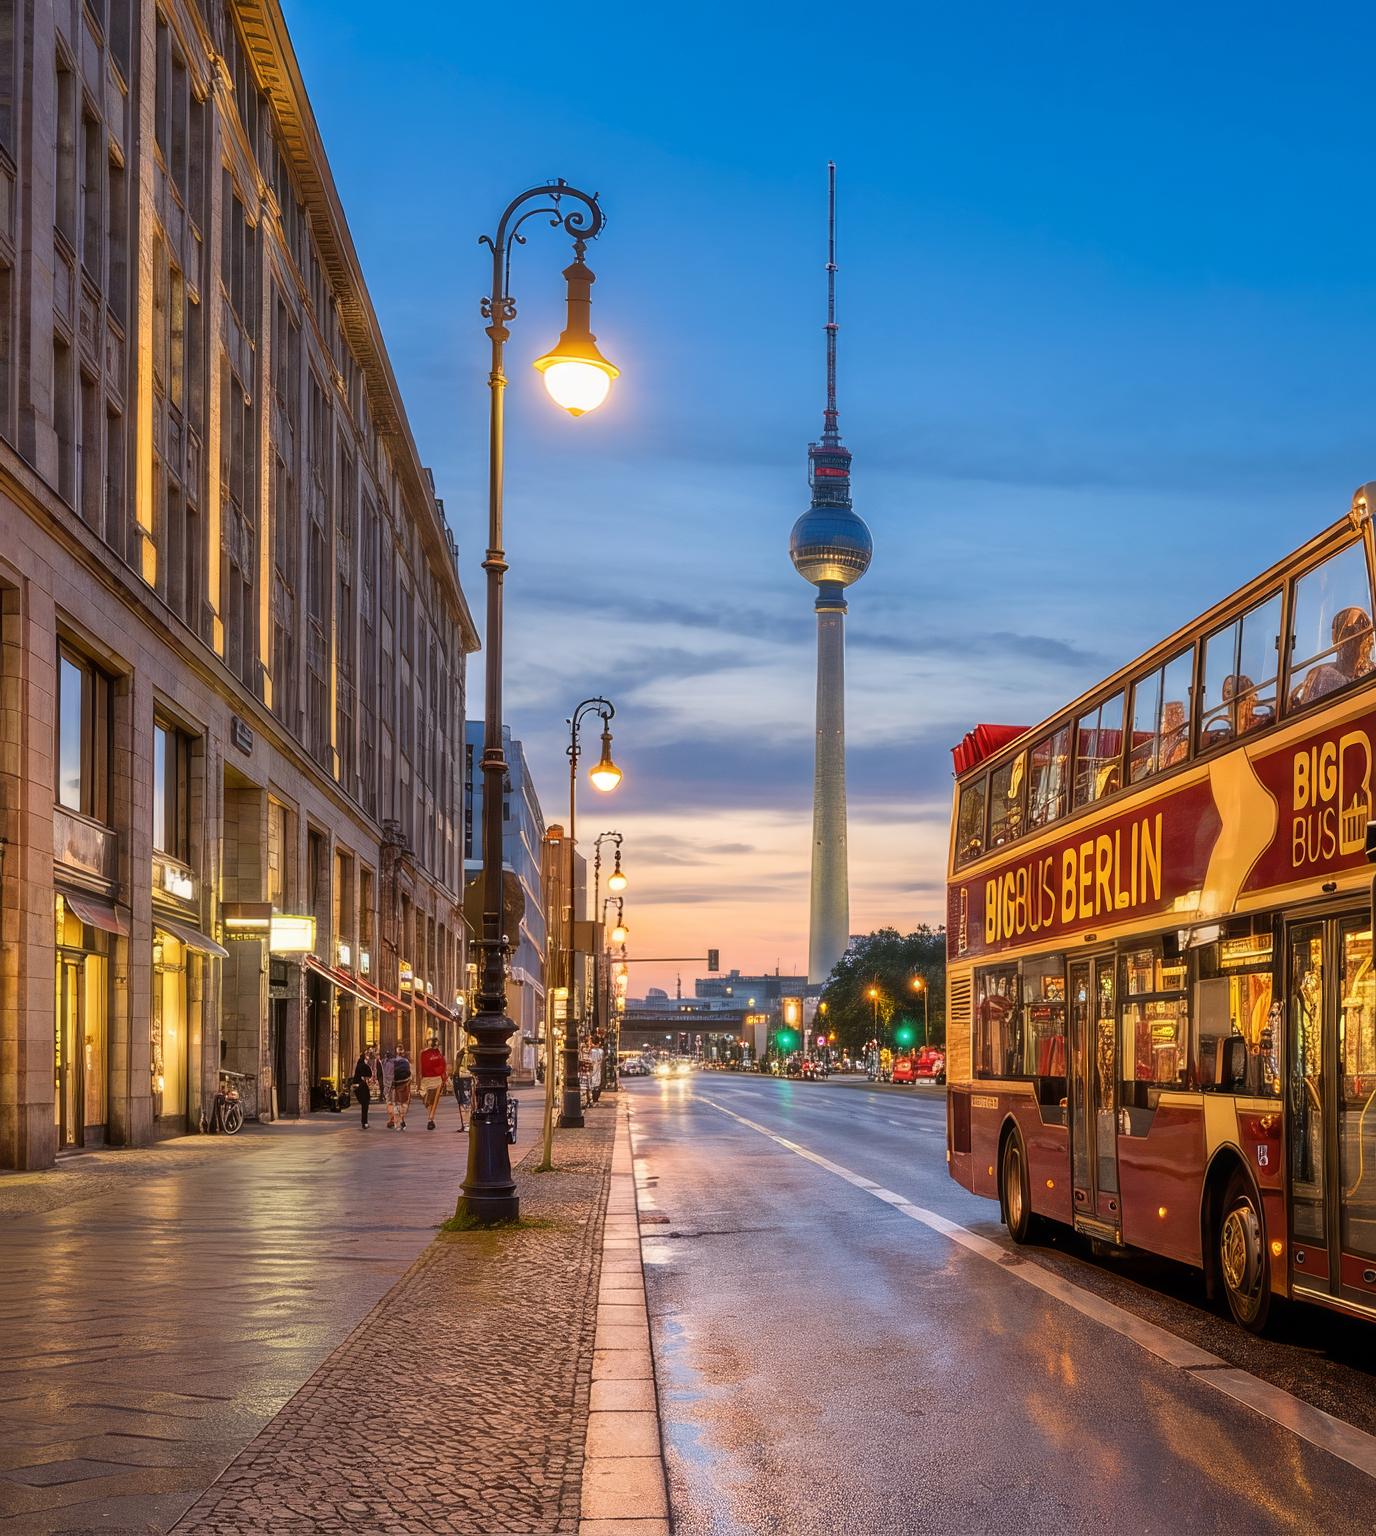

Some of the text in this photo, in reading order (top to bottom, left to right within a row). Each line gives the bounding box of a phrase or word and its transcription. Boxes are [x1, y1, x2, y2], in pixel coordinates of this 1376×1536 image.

[1293, 741, 1337, 811] BIG
[1061, 812, 1163, 924] BERLIN
[1292, 807, 1336, 868] BUS
